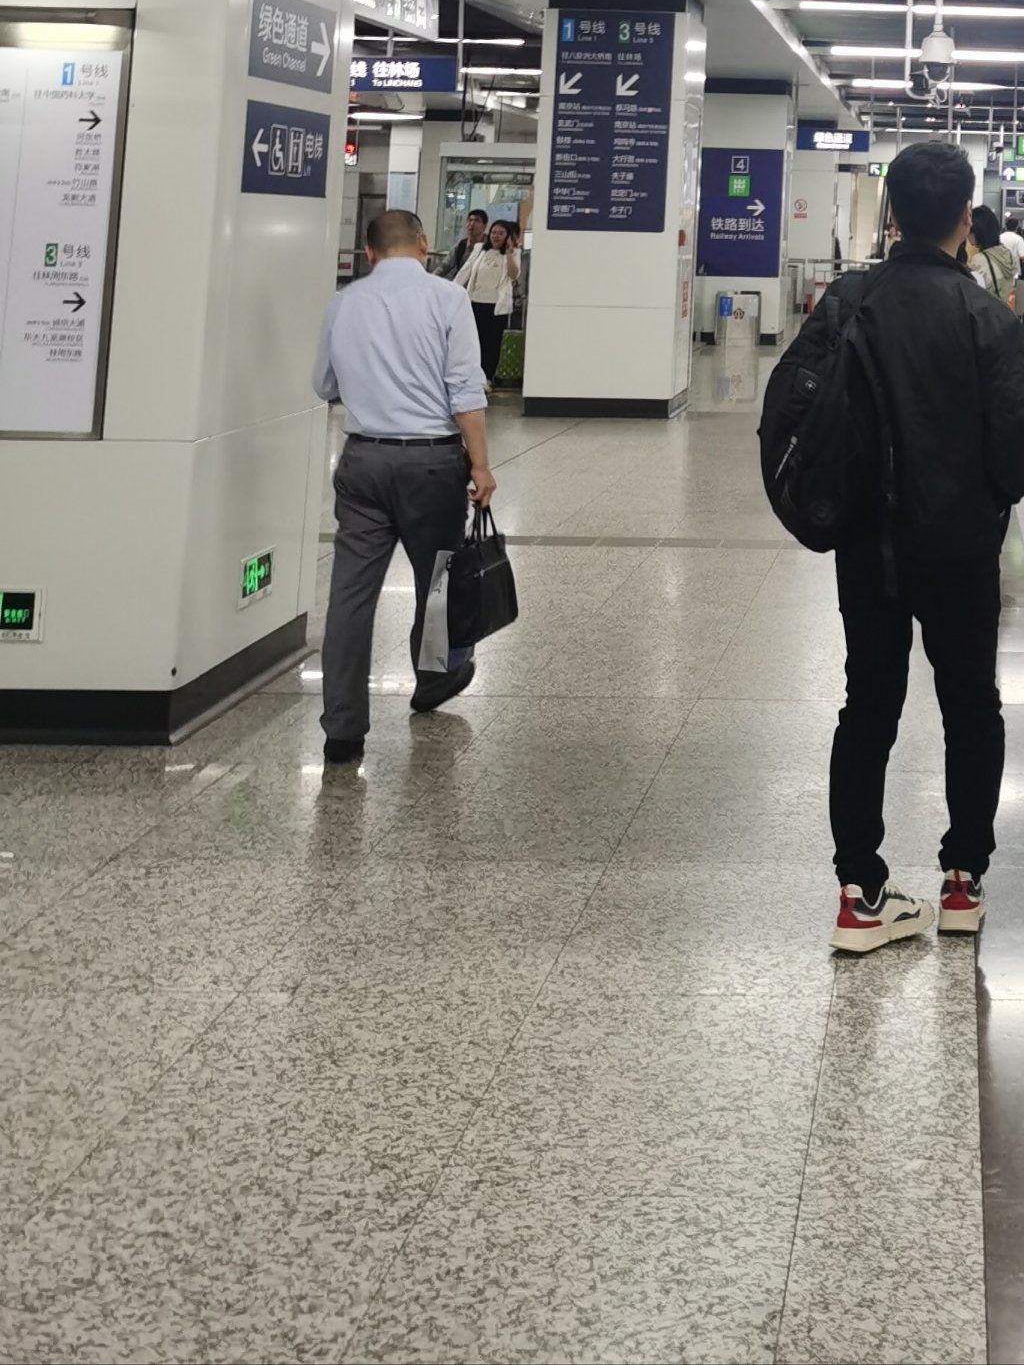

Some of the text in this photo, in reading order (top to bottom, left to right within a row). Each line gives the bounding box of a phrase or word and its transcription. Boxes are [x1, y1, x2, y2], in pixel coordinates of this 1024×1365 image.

[258, 3, 309, 52] 绿色通道
[580, 20, 606, 35] 号线
[620, 23, 630, 41] 3
[635, 22, 661, 36] 号线
[372, 61, 421, 79] 往林场
[305, 132, 323, 160] 电梯
[711, 217, 765, 232] 铁路到达
[63, 243, 90, 259] 号线
